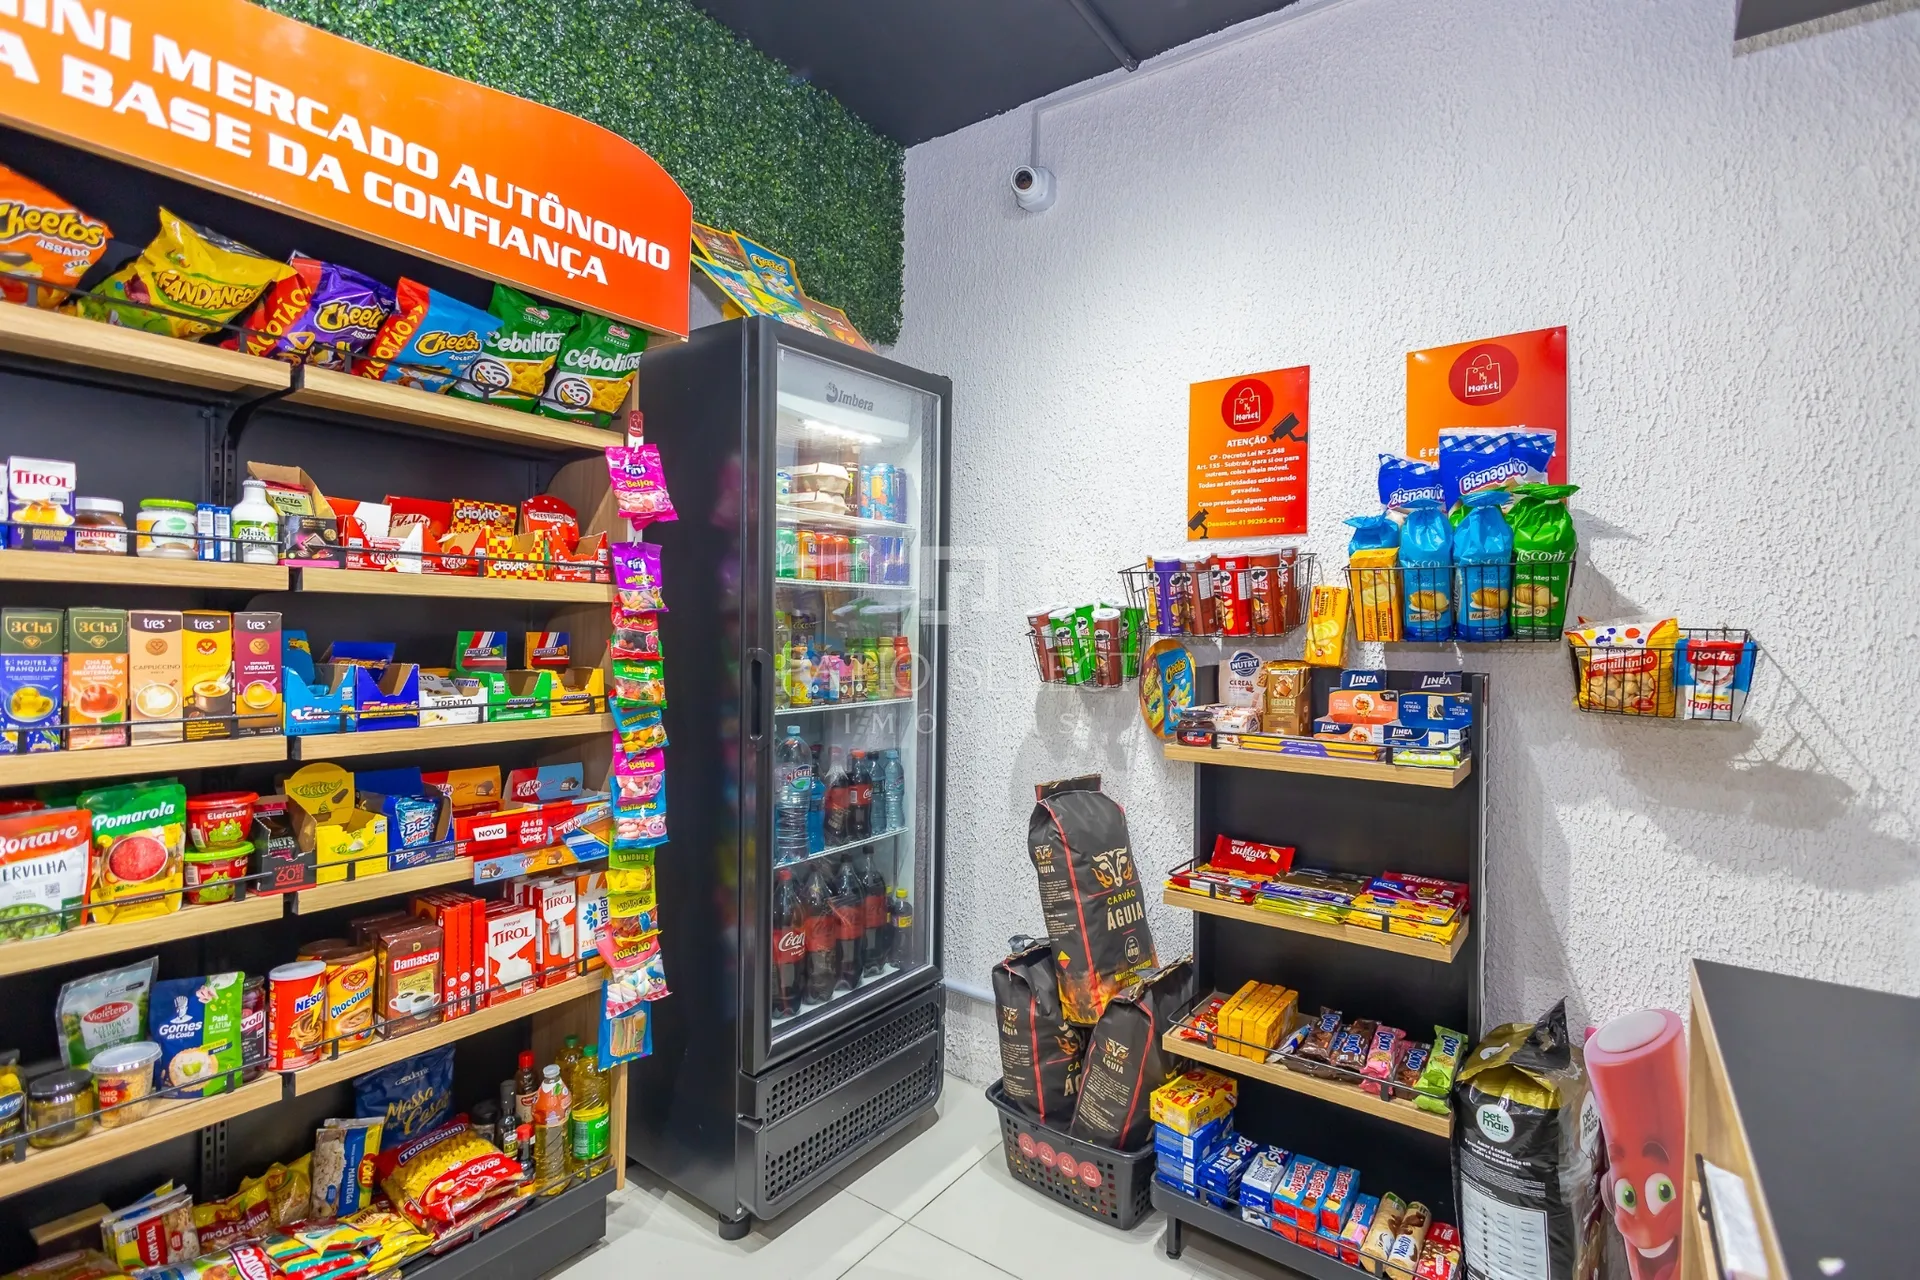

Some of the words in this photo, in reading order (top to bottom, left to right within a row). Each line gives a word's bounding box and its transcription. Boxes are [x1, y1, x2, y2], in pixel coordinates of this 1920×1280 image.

[0, 0, 132, 61] INI
[153, 33, 439, 180] MERCADO
[450, 163, 672, 272] AUTÔNOMO
[61, 54, 252, 158] BASE
[268, 137, 350, 194] DA
[363, 171, 608, 286] CONFIANÇA
[36, 239, 91, 257] ASSADO
[158, 270, 260, 309] FANDANGOS
[1478, 371, 1487, 384] My
[1468, 381, 1499, 393] Market
[838, 390, 874, 411] Imbera
[1226, 435, 1268, 448] ATENÇÃO
[1222, 451, 1246, 459] Decreto
[1247, 449, 1257, 457] Lei
[1266, 447, 1285, 455] 2.848
[1420, 447, 1427, 458] É
[1224, 460, 1251, 468] Subtrair,
[1252, 459, 1267, 467] para
[1284, 455, 1300, 463] para
[625, 463, 647, 475] Fini
[1205, 470, 1229, 478] outrem,
[1247, 466, 1267, 474] alheia
[1267, 464, 1289, 472] móvel.
[1462, 459, 1527, 492] Bisnaguito
[13, 469, 73, 490] TIROL
[625, 478, 654, 489] Beijos
[1198, 481, 1216, 489] Todas
[1224, 479, 1257, 487] atividades
[1276, 474, 1296, 482] sendo
[1230, 487, 1261, 496] gravadas.
[1391, 485, 1445, 506] Bisnaguit
[1213, 497, 1243, 507] presencie
[1243, 496, 1267, 505] alguma
[1268, 494, 1296, 503] situação
[1225, 505, 1266, 514] inadequada.
[1532, 574, 1560, 582] ntegral
[143, 617, 165, 630] tres
[194, 618, 215, 630] tres
[246, 618, 266, 630] tres
[5, 665, 58, 673] TRANQUILAS
[1231, 658, 1259, 670] NUTRY
[1349, 673, 1378, 687] LINEA
[1421, 675, 1452, 689] LINEA
[1687, 698, 1732, 711] Tapioca
[1320, 723, 1341, 732] LINEA
[1391, 727, 1413, 737] LINEA
[627, 760, 655, 771] Beijos
[518, 780, 541, 796] KitKat
[92, 801, 176, 831] Pomarola
[206, 809, 247, 821] Elefante
[520, 820, 529, 828] Já
[478, 827, 504, 838] NOVO
[1230, 844, 1269, 861] suflair
[3, 859, 67, 882] ERVILHA
[1372, 880, 1398, 889] LACTA
[544, 895, 575, 911] TIROL
[1107, 888, 1136, 905] CARVÃO
[1107, 900, 1144, 931] ÁGUIA
[492, 926, 532, 947] TIROL
[612, 941, 651, 962] TORÇÃO
[393, 951, 440, 972] Damasco
[295, 990, 326, 1014] NESC
[88, 1005, 128, 1021] Violetera
[212, 1013, 229, 1022] Patê
[159, 1020, 203, 1036] Gomes
[176, 1031, 195, 1039] Costa
[384, 1086, 434, 1123] Massa
[1482, 1110, 1501, 1124] pet
[1581, 1103, 1595, 1127] pet
[1482, 1119, 1510, 1134] mais
[1582, 1118, 1598, 1140] mais
[400, 1123, 463, 1161] TODESCHINI
[1477, 1139, 1490, 1149] Amor
[1495, 1147, 1513, 1158] cuidar,
[345, 1167, 356, 1205] MANTEIGA
[201, 1226, 235, 1243] PIPOCA
